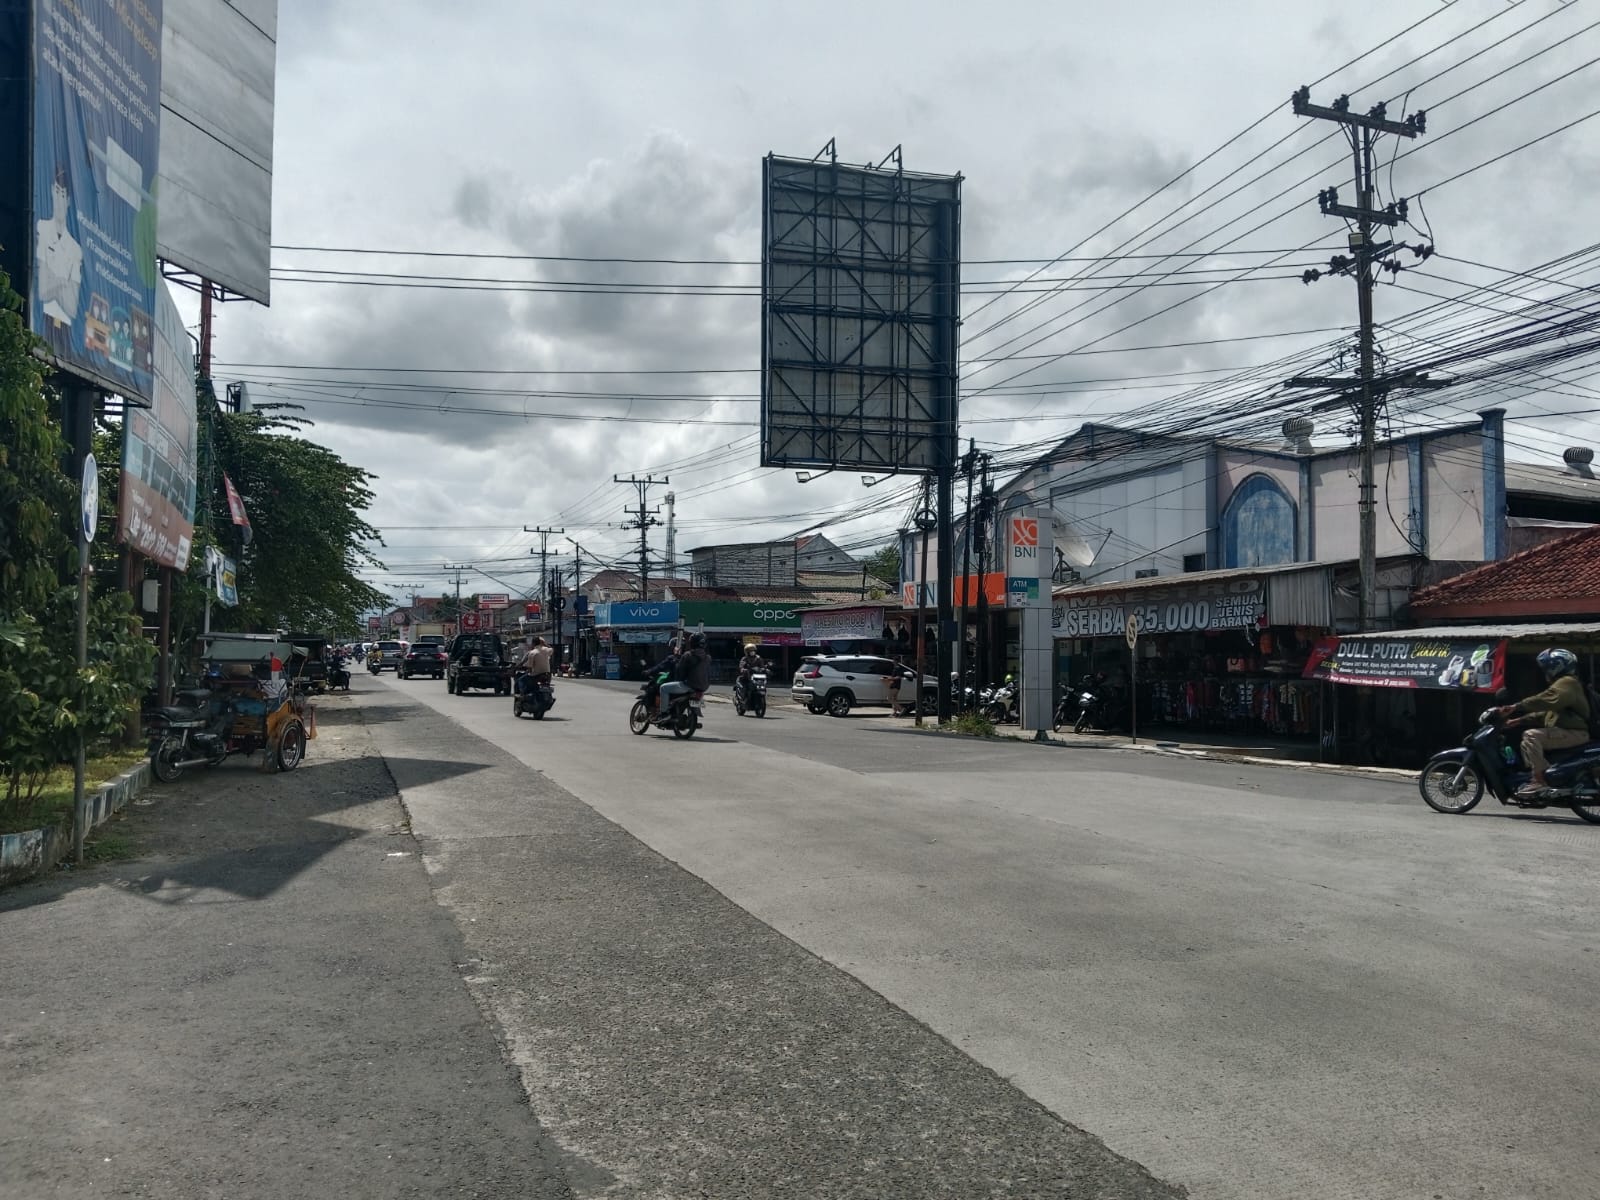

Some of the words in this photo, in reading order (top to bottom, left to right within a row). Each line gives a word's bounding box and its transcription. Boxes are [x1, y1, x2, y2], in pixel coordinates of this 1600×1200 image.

[1014, 546, 1037, 558] BNI
[1012, 580, 1028, 588] ATM
[1215, 594, 1259, 608] SEMUA
[629, 606, 660, 617] vivo
[1218, 605, 1254, 617] JENIS
[1067, 607, 1126, 637] SERBA
[1337, 642, 1369, 659] DULL
[1370, 643, 1410, 660] PUTRI
